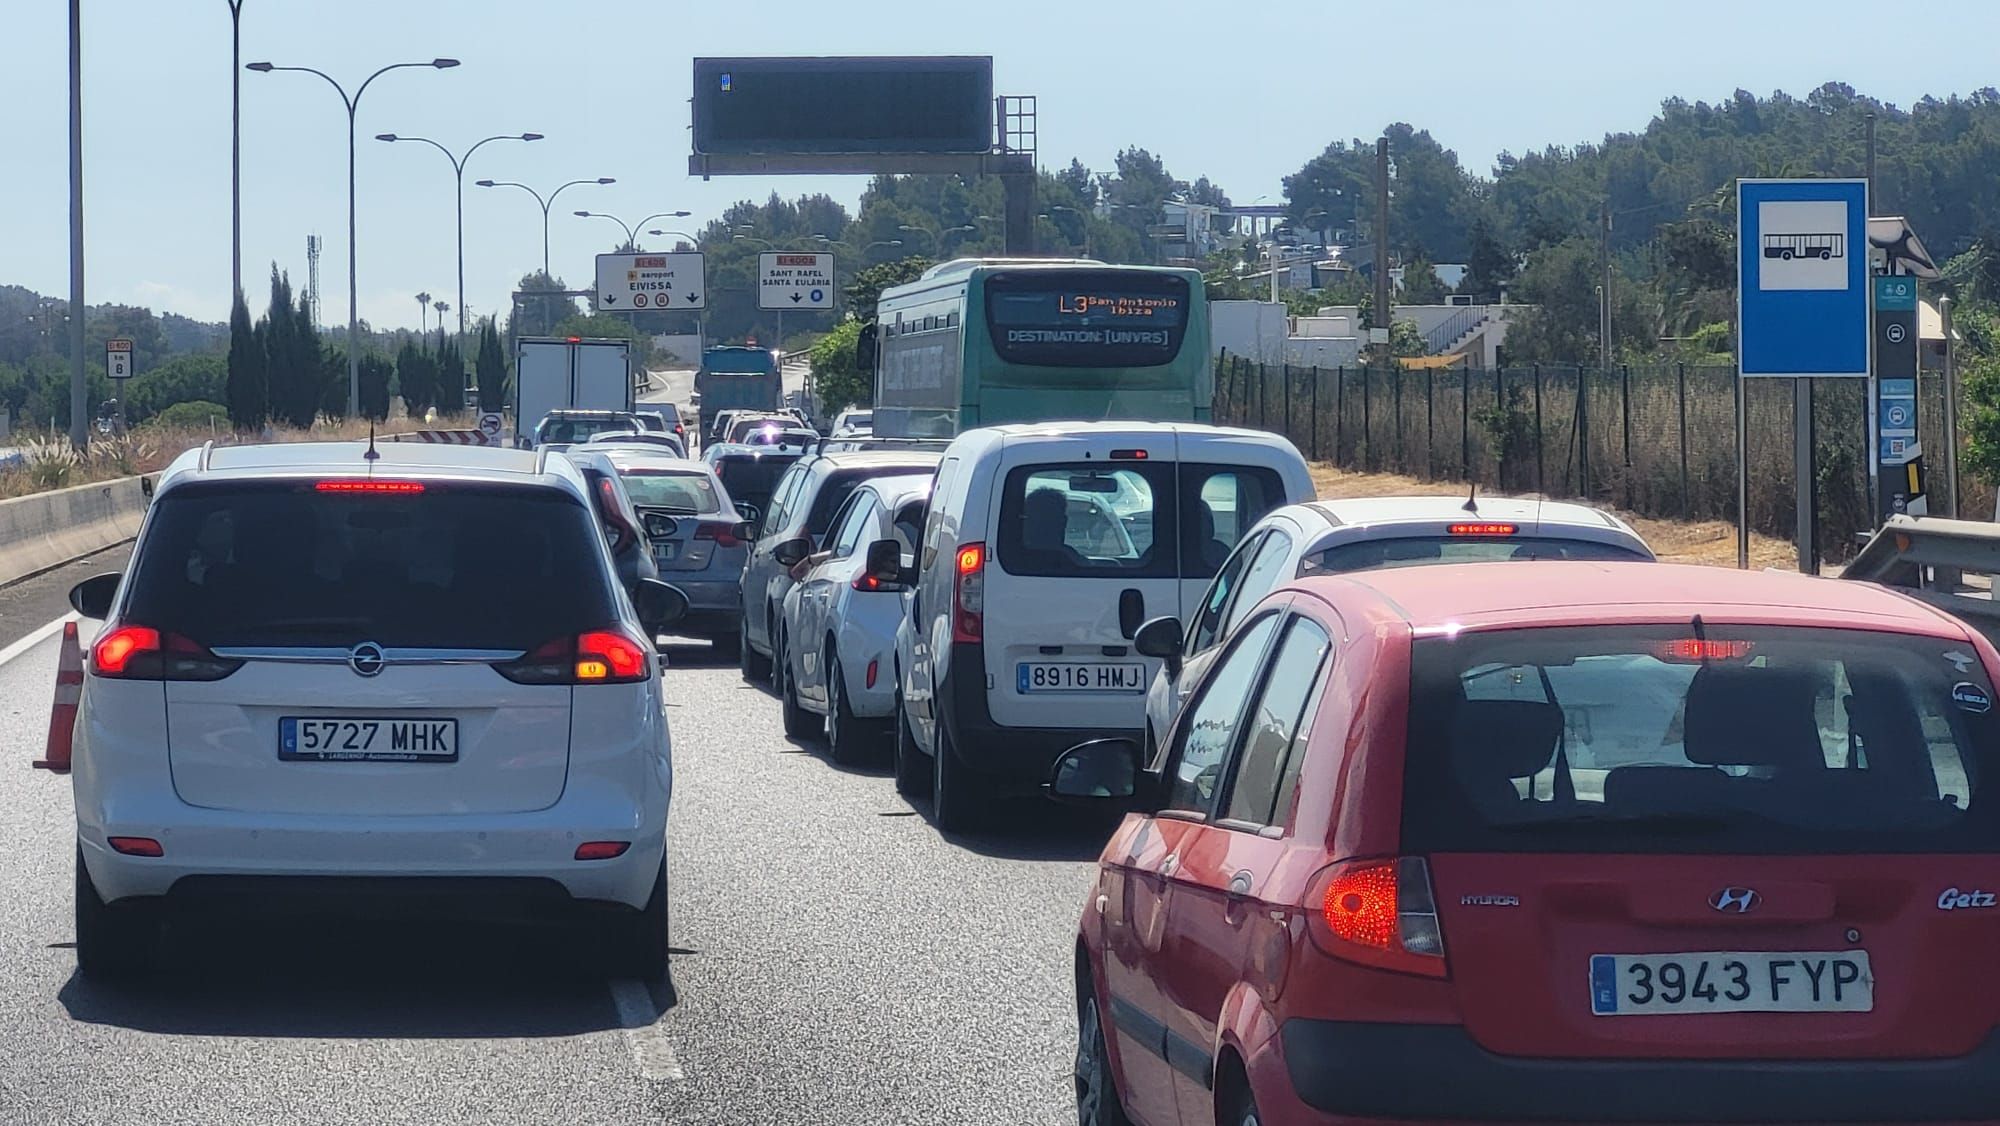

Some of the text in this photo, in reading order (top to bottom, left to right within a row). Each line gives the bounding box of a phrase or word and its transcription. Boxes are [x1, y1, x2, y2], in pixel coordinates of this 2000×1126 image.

[630, 281, 672, 291] EIVISSA
[1059, 295, 1089, 313] L3
[1089, 296, 1177, 308] San Antonio
[1111, 307, 1153, 316] Ibiza
[1008, 329, 1103, 344] DESTINATION:
[116, 363, 123, 374] 8
[1033, 667, 1089, 687] 8916
[1097, 667, 1138, 688] HMJ
[302, 722, 448, 751] 5727 MHK
[1460, 895, 1520, 906] HYUNDAI
[1937, 888, 1997, 910] Getz
[1627, 959, 1860, 1004] 3943 FYP
